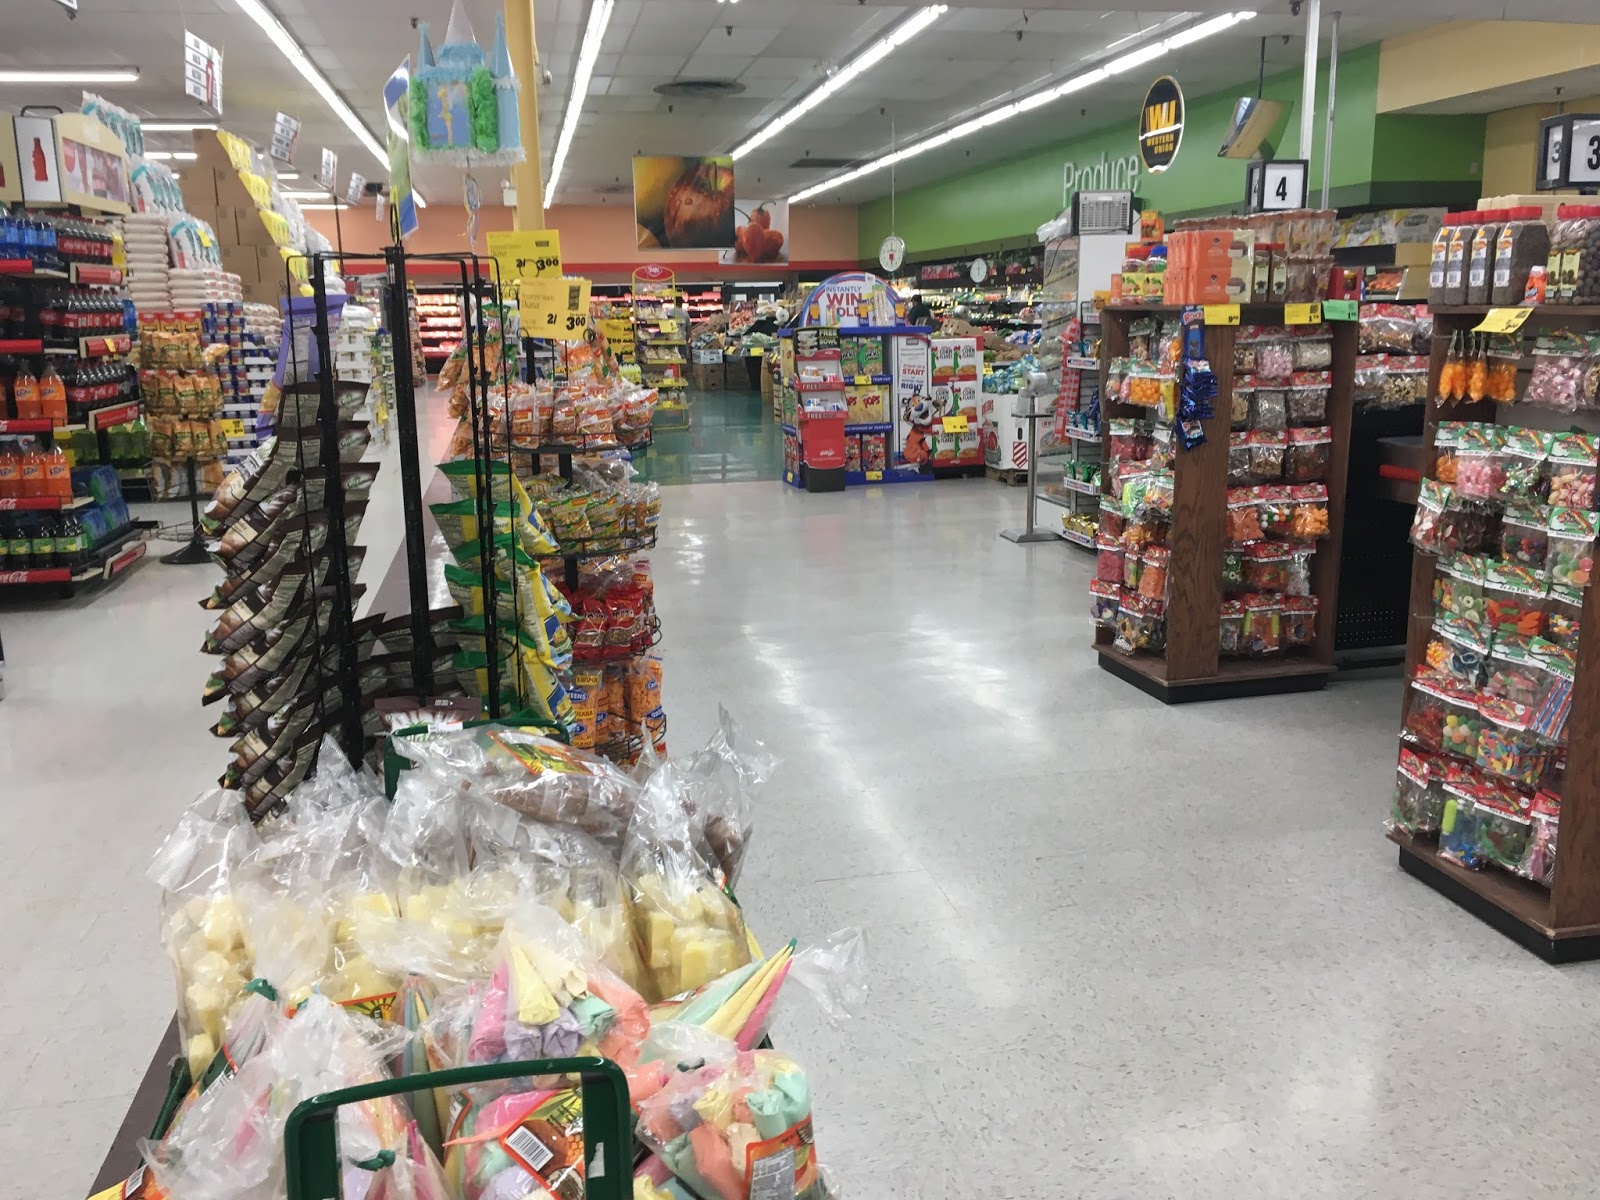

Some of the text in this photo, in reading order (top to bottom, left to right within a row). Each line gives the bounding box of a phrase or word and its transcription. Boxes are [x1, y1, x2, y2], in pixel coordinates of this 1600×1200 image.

[1146, 100, 1176, 132] WU
[1146, 134, 1174, 147] WESTERN
[1154, 143, 1174, 154] UNION
[1551, 141, 1562, 164] 3
[1587, 135, 1600, 170] 3
[1062, 150, 1141, 208] Produce
[1275, 176, 1288, 202] 4
[826, 292, 862, 306] WIN
[547, 314, 557, 325] 2/
[900, 382, 924, 390] RIGHT
[863, 395, 880, 408] POPS
